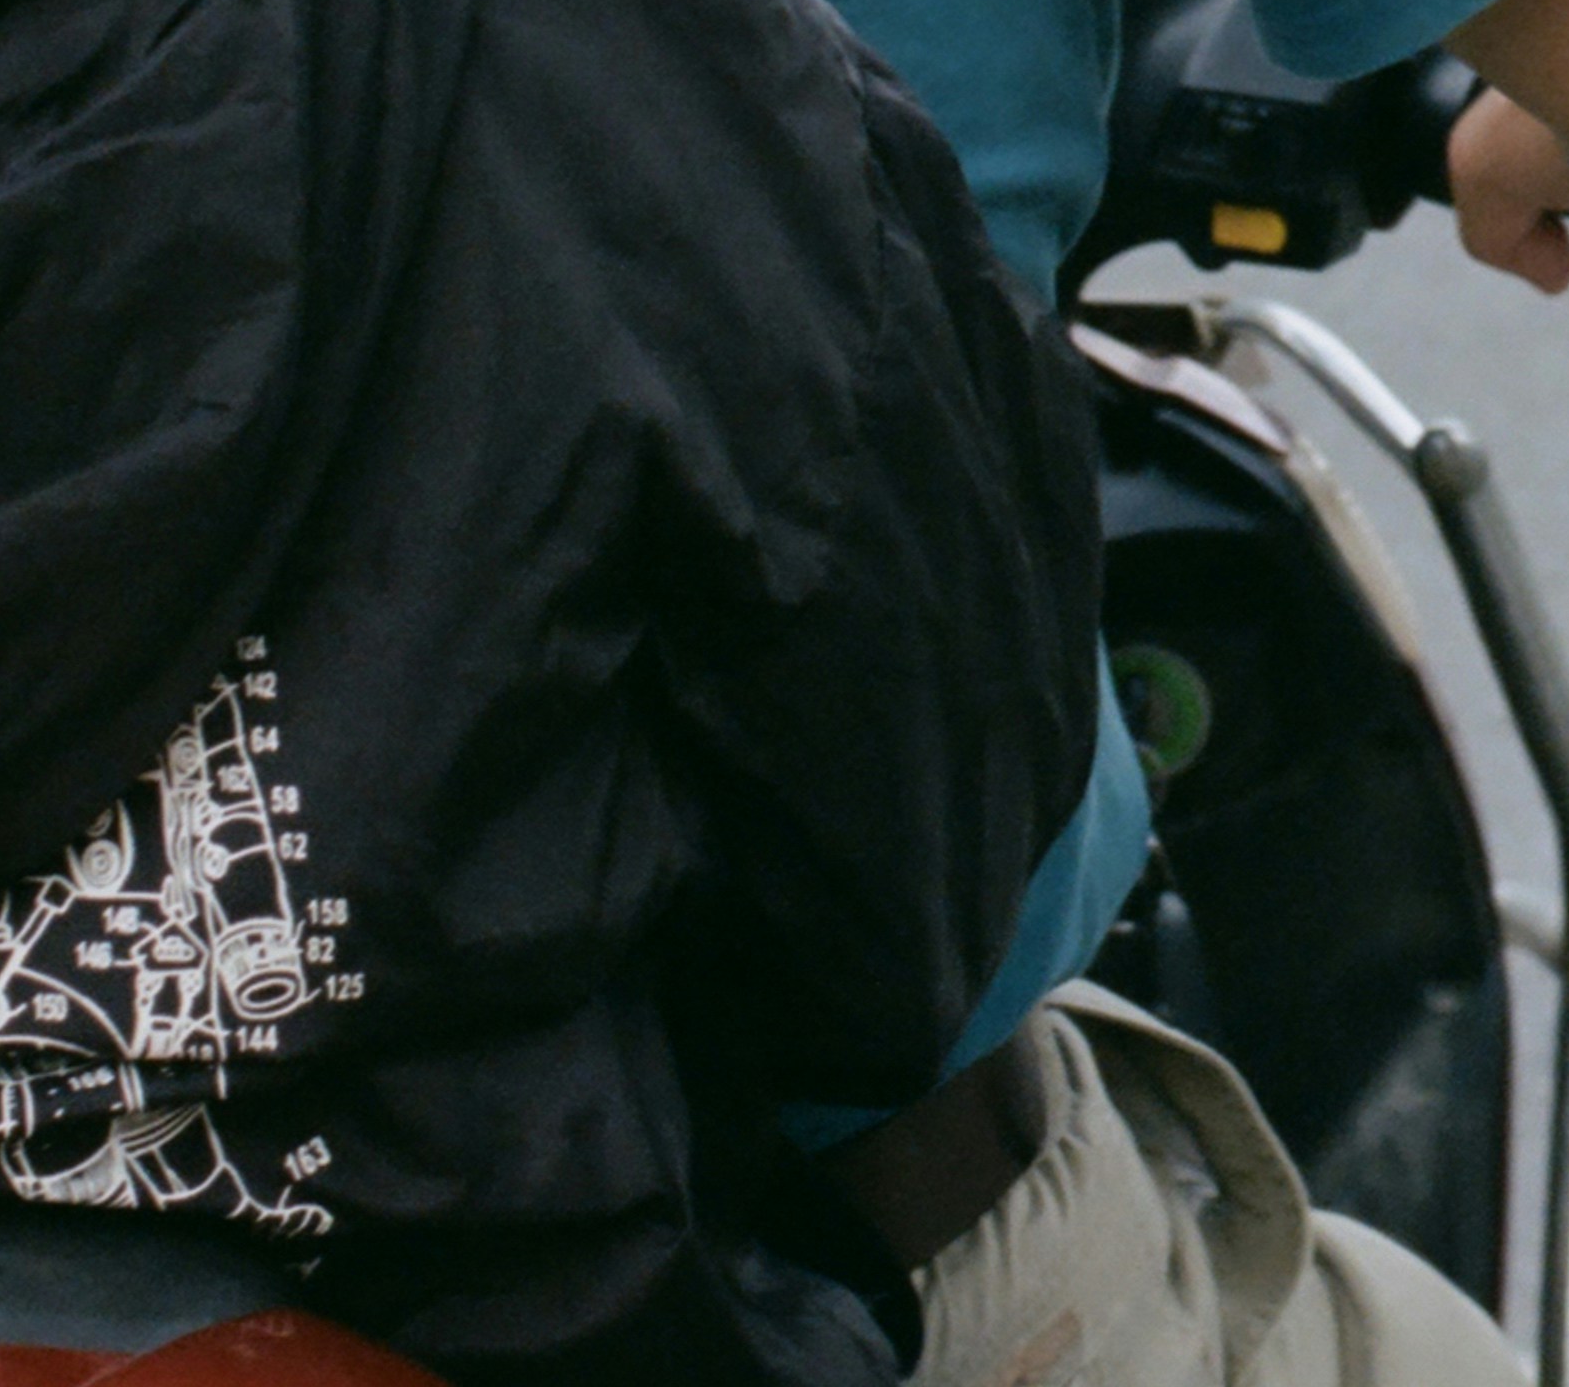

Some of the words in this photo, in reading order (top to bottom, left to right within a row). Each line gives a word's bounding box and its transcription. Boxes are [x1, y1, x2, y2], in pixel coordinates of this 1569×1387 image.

[279, 832, 309, 861] 62
[325, 973, 365, 1001] 125
[235, 1025, 279, 1052] 144
[284, 1135, 332, 1182] 163
